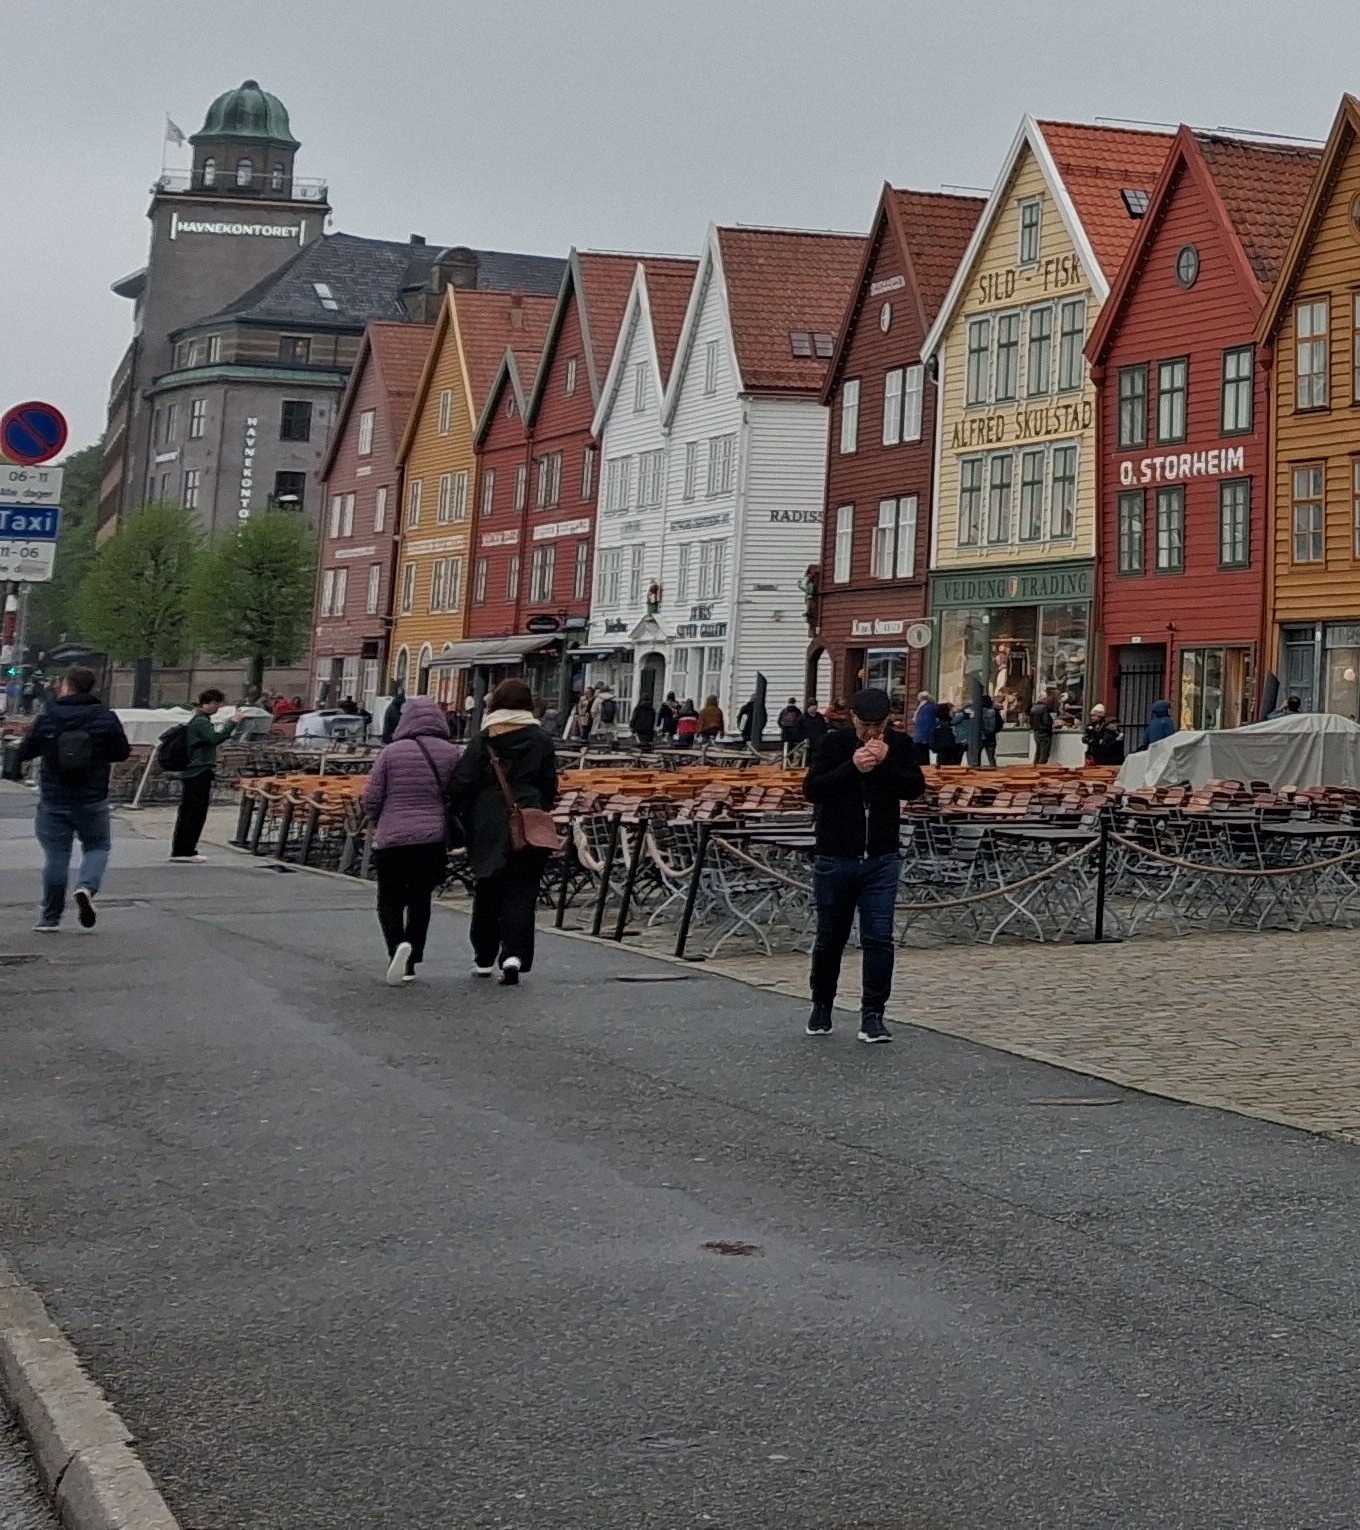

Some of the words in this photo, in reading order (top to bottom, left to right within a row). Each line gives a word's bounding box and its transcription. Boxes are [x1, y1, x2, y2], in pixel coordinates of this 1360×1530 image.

[177, 221, 299, 237] HAVNEKONTORET
[978, 269, 1016, 305] SILD
[1043, 253, 1081, 292] FISK
[952, 414, 1005, 448] ALFRED
[1015, 401, 1092, 440] SKULSTAD
[0, 510, 52, 532] Taxi
[944, 580, 1005, 600] VEIDUNG
[1021, 573, 1087, 596] TRADING
